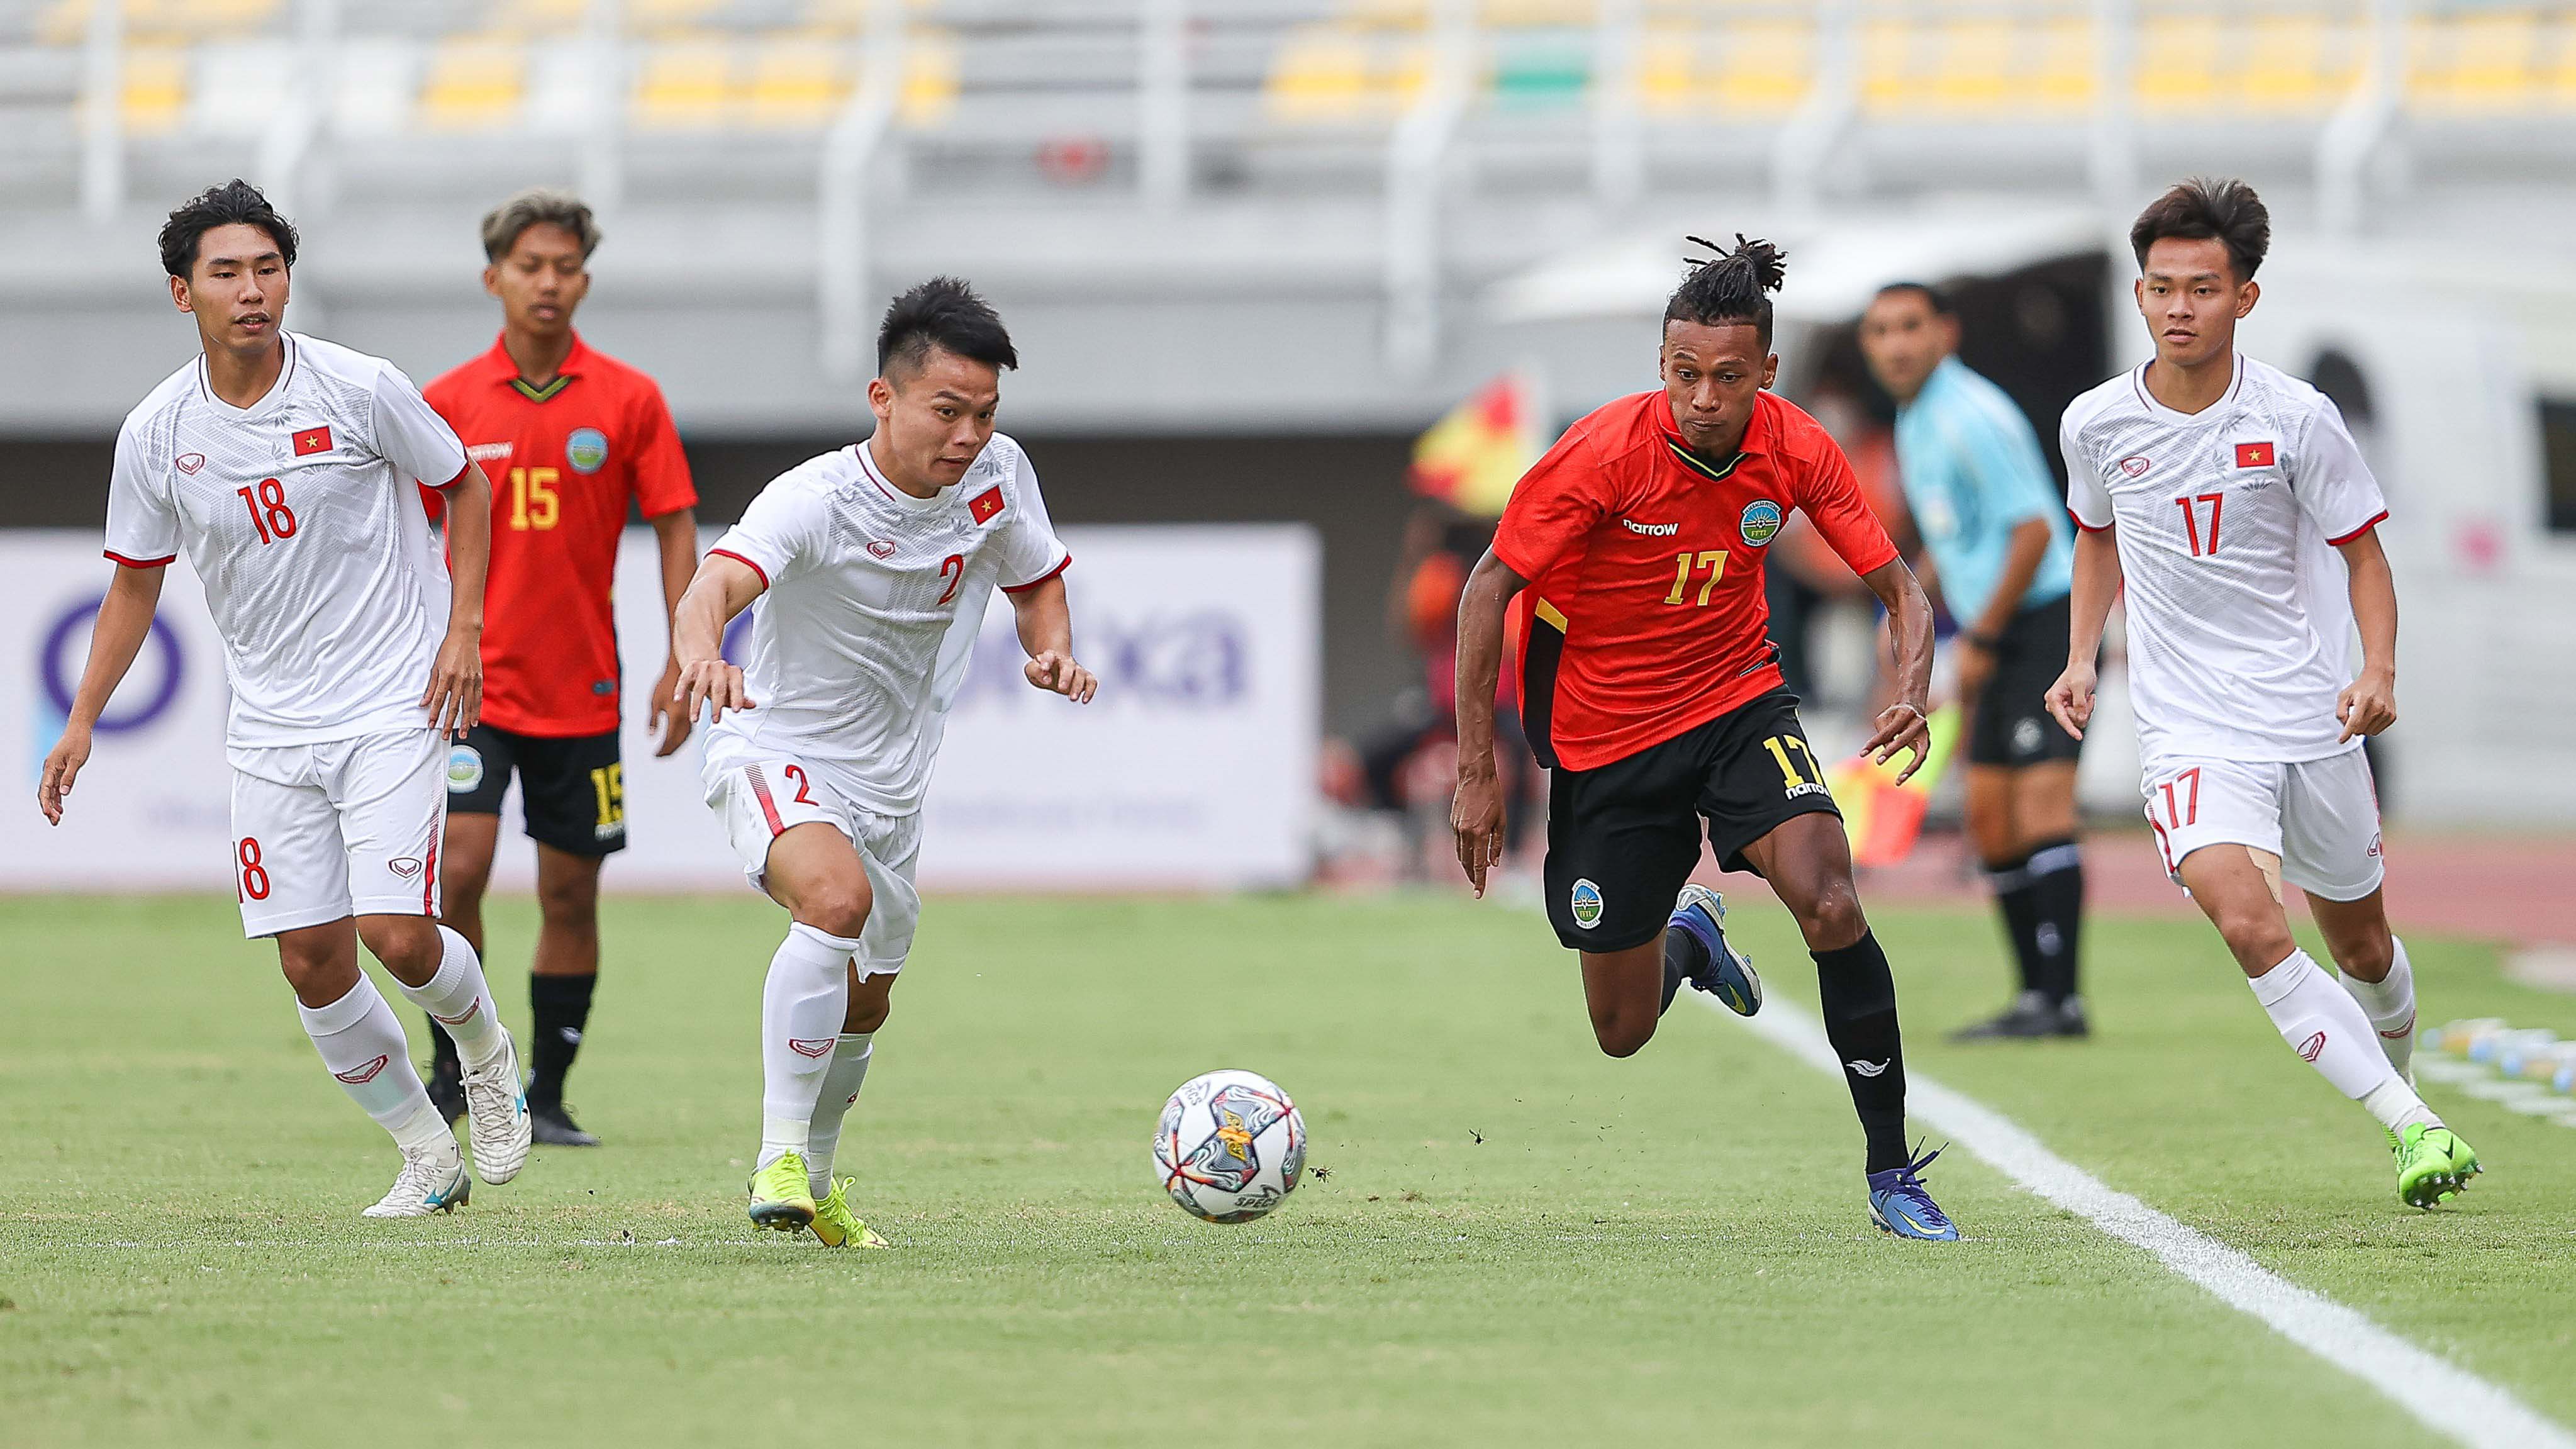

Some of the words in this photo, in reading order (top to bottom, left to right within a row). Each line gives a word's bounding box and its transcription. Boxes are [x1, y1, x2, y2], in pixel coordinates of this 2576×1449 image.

[237, 477, 297, 545] 18
[510, 466, 560, 531] 15
[2175, 492, 2223, 557] 17
[1623, 519, 1678, 536] narrow
[935, 554, 964, 607] 2
[1664, 550, 1729, 606] 17
[785, 764, 820, 807] 2
[1763, 734, 1824, 788] 17
[2158, 766, 2200, 831] 17
[1234, 1196, 1280, 1207] SPECS
